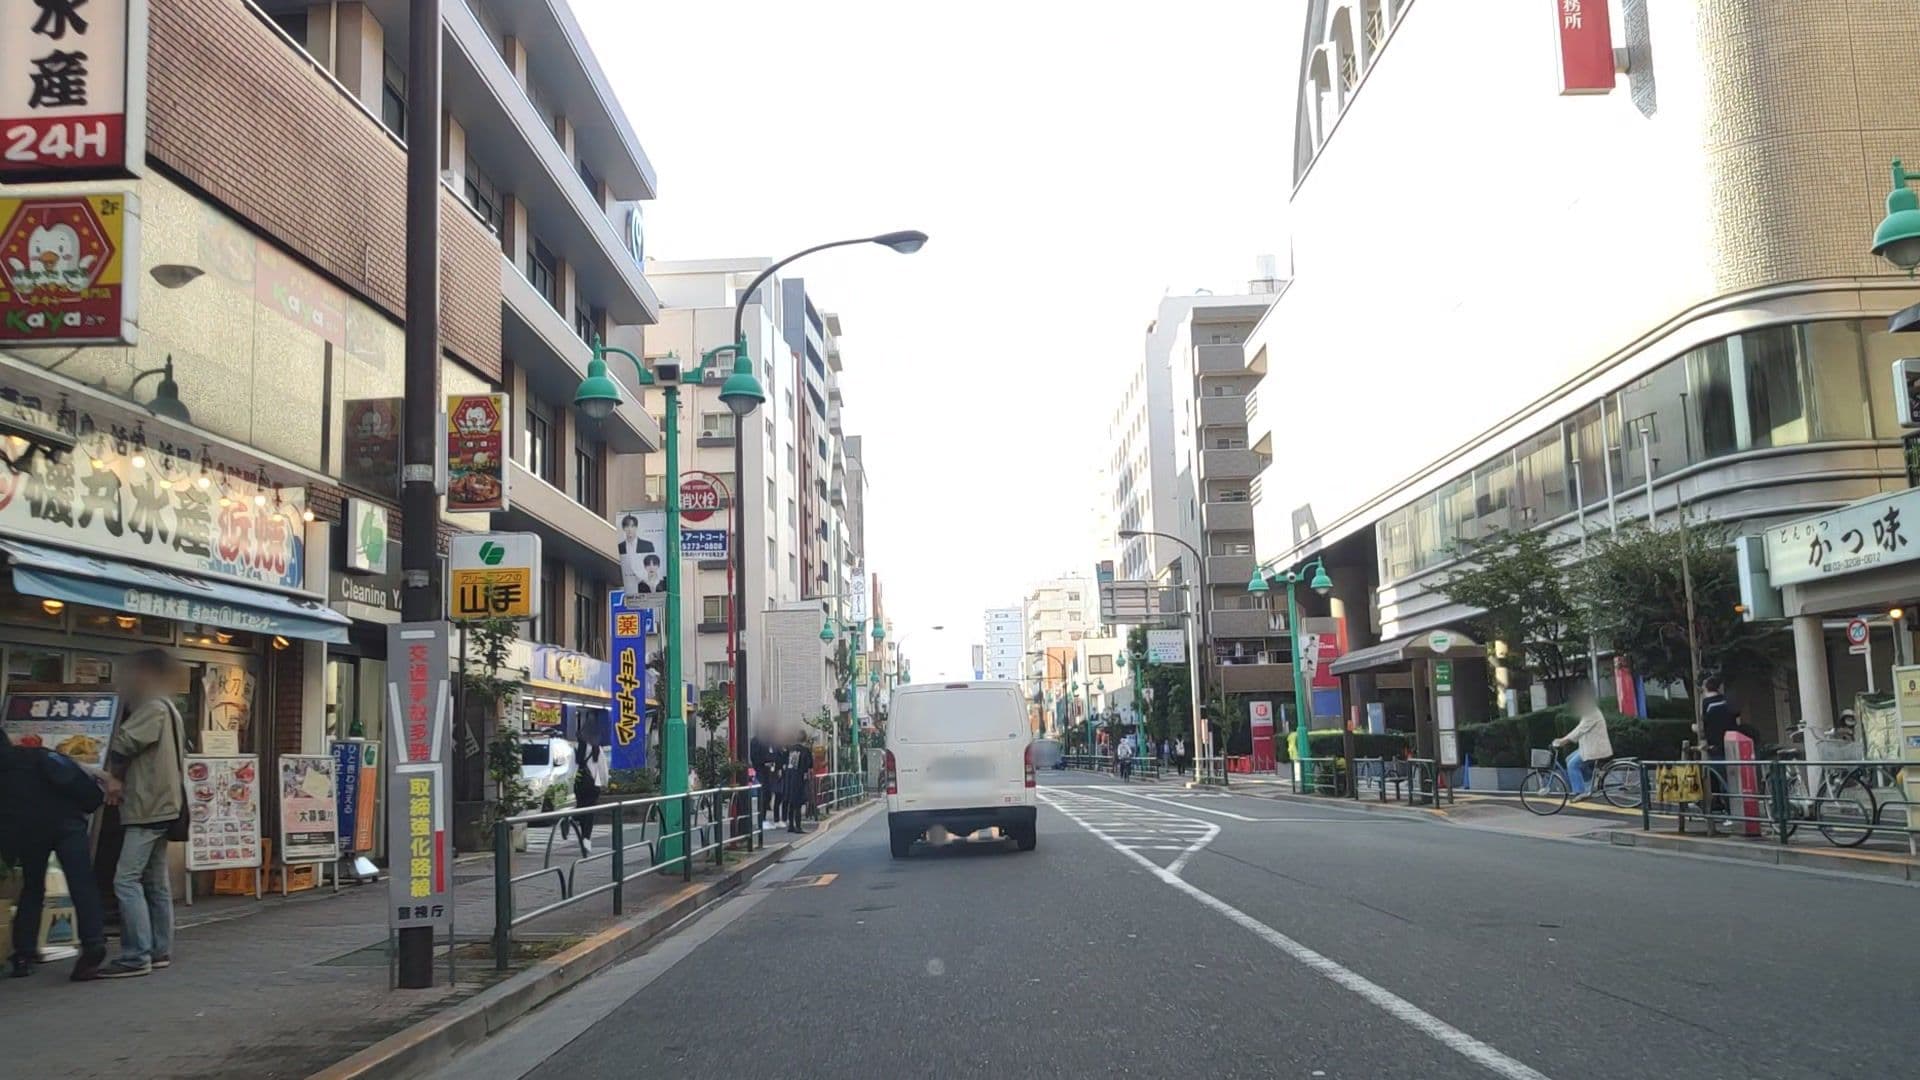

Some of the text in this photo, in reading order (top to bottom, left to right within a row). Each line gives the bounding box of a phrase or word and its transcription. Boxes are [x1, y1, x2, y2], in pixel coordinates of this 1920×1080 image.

[5, 121, 107, 161] 24H
[101, 199, 120, 215] 2F
[1781, 520, 1829, 543] とんかつ
[1809, 506, 1908, 567] かつ味
[342, 578, 387, 609] Cleaning
[460, 584, 522, 613] 山手
[617, 615, 639, 635] 薬
[409, 645, 428, 761] 交通事故多発
[615, 648, 640, 746] マツモトキヨシ
[409, 778, 431, 898] 取締強化路線
[398, 904, 444, 920] 警視庁
